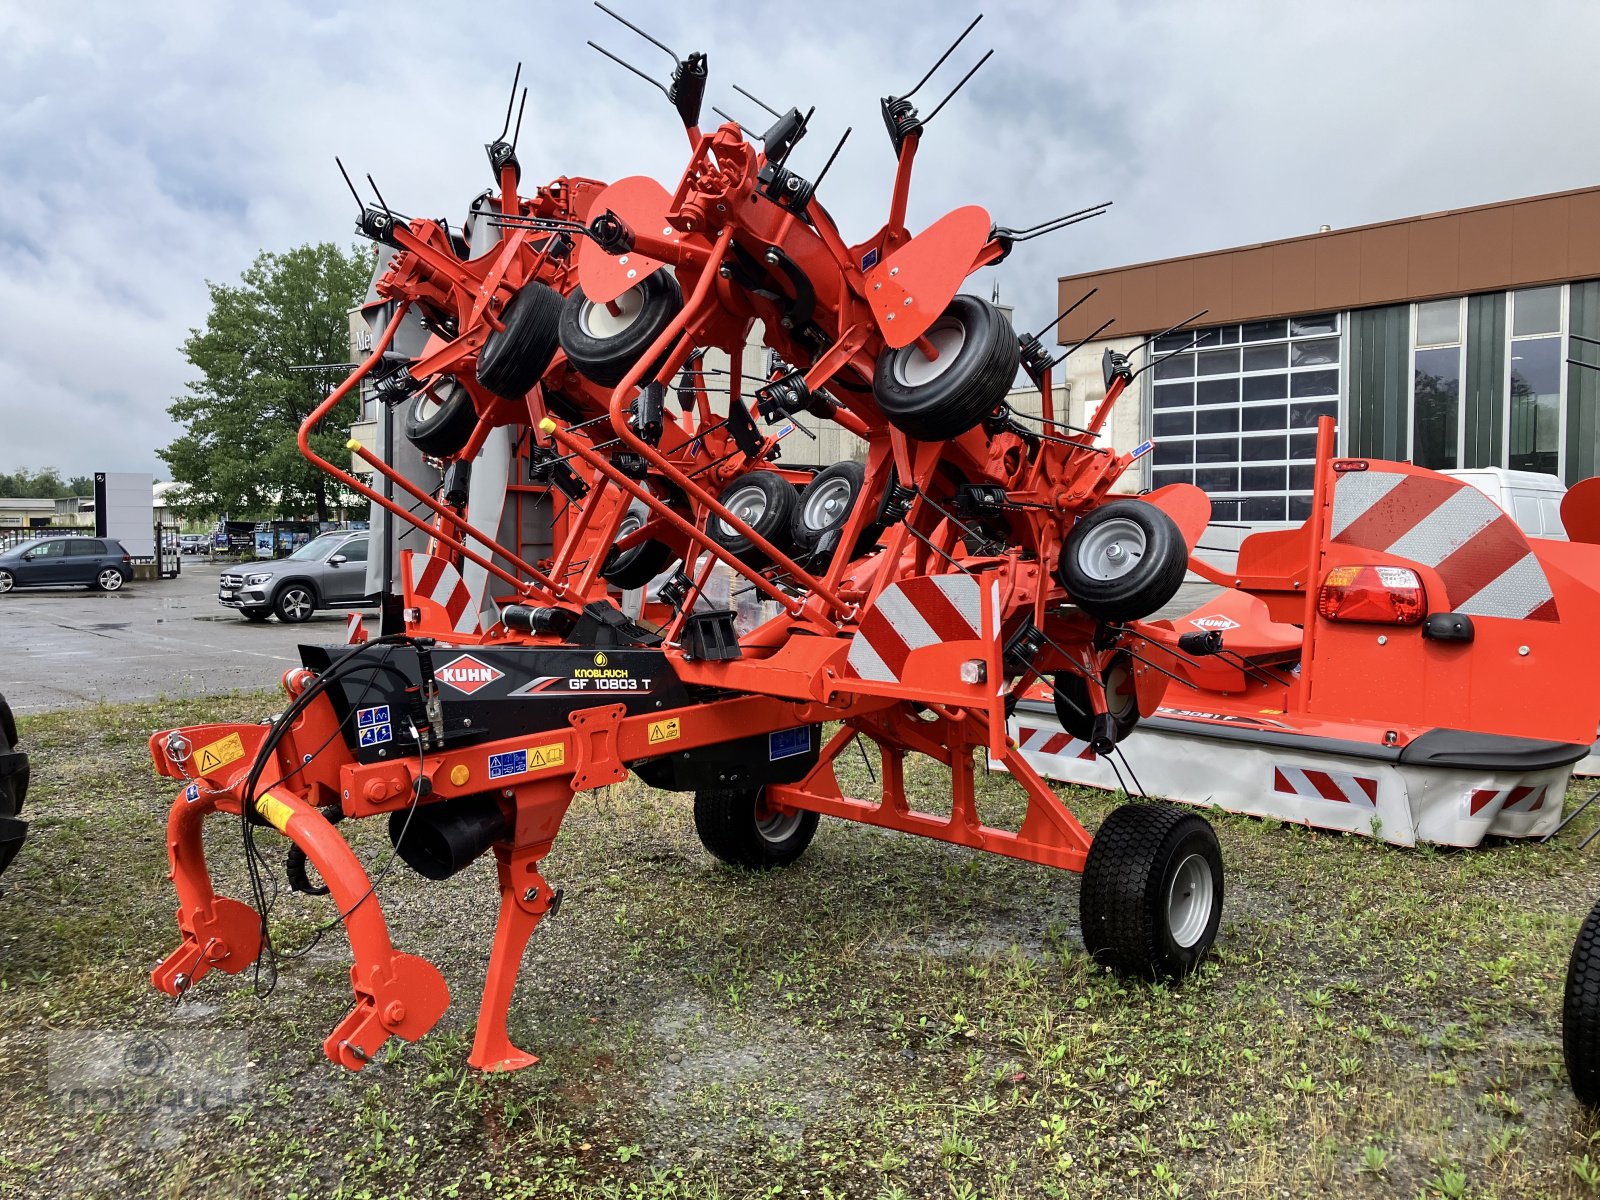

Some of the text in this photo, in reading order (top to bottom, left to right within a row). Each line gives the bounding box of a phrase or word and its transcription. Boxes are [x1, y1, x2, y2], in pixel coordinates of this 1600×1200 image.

[1197, 617, 1232, 628] KUHN
[443, 668, 492, 682] KUHN
[574, 668, 629, 678] KNOBLAUCH
[569, 678, 652, 690] GF 10803 T
